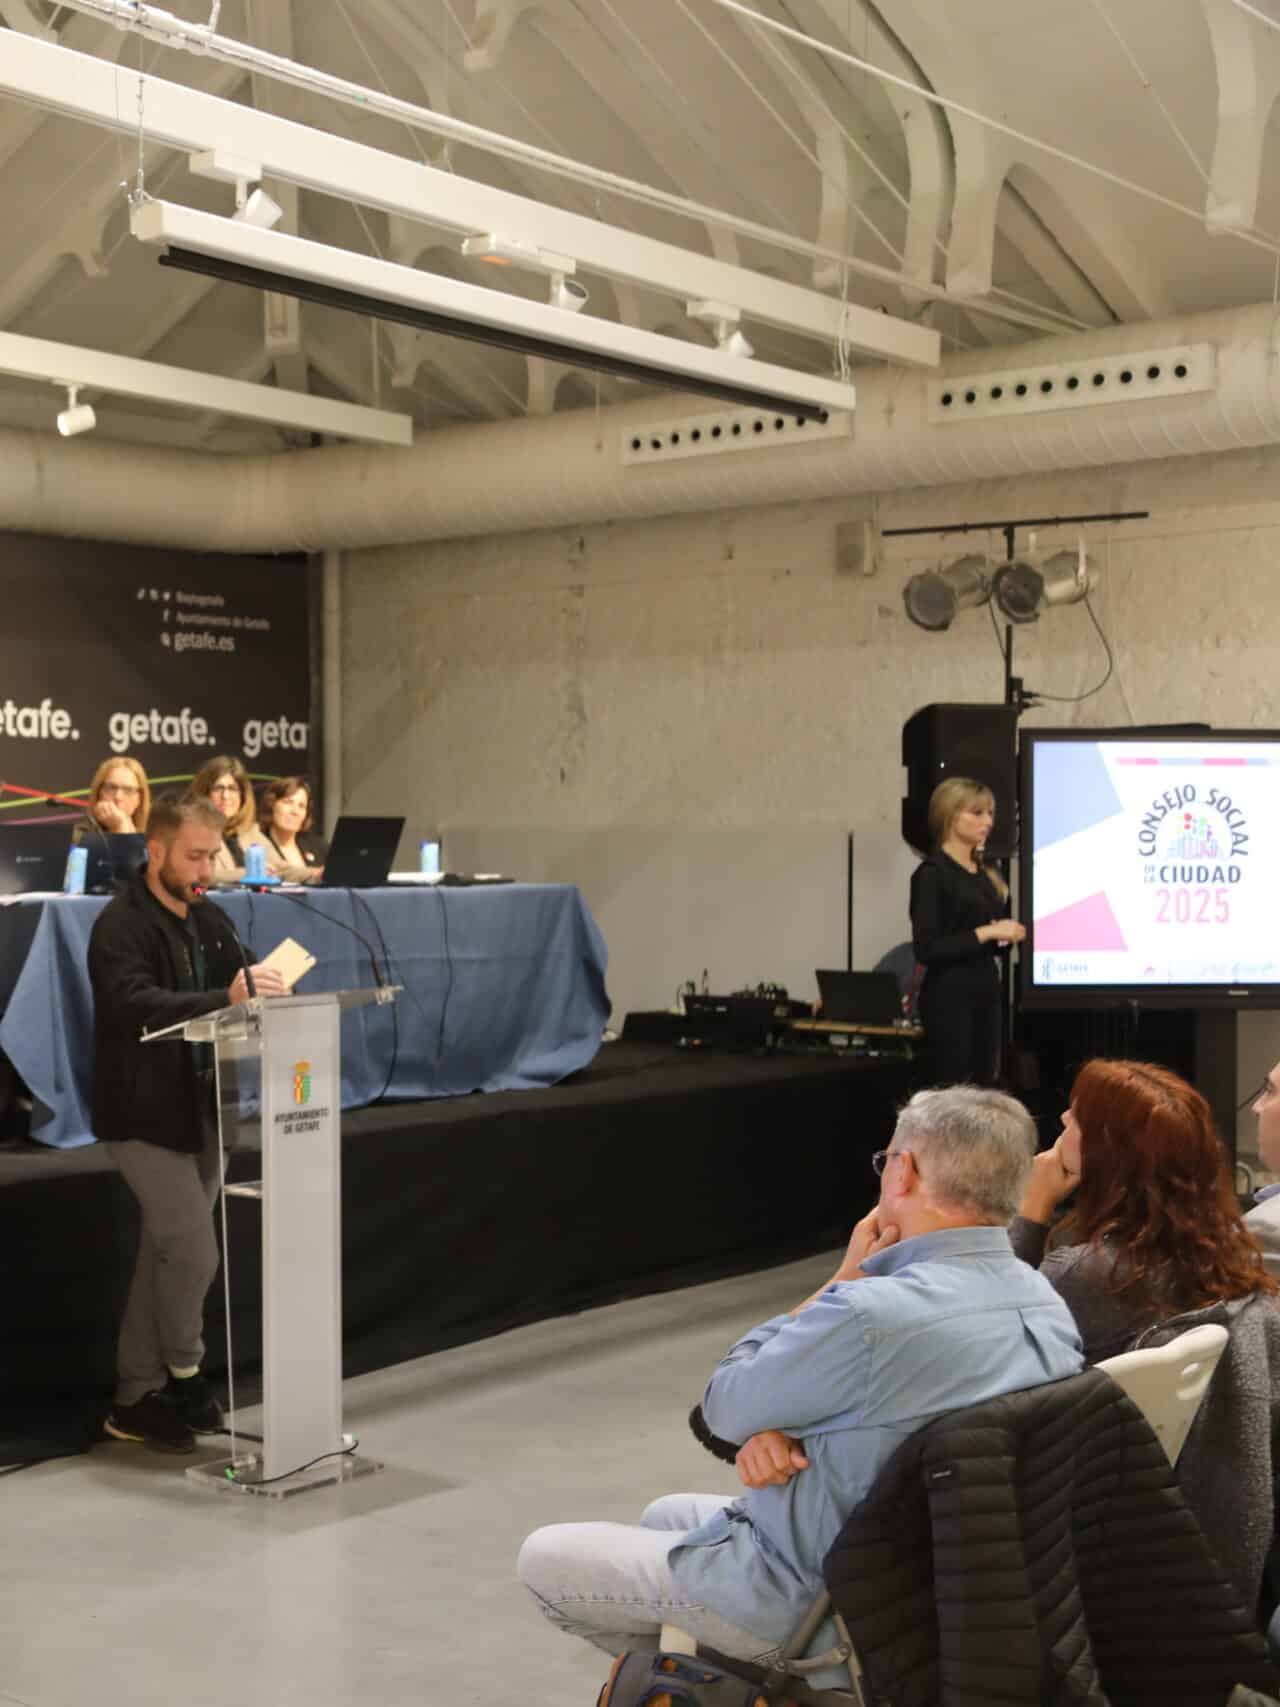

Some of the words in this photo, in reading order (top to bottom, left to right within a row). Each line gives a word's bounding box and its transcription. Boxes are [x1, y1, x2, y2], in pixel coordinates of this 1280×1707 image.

[174, 631, 236, 652] getafe.es
[109, 707, 216, 753] getafe.
[1138, 784, 1196, 857] CONSEJO
[1204, 788, 1249, 857] SOCIAL
[1159, 865, 1241, 884] CIUDAD
[1154, 887, 1230, 924] 2025
